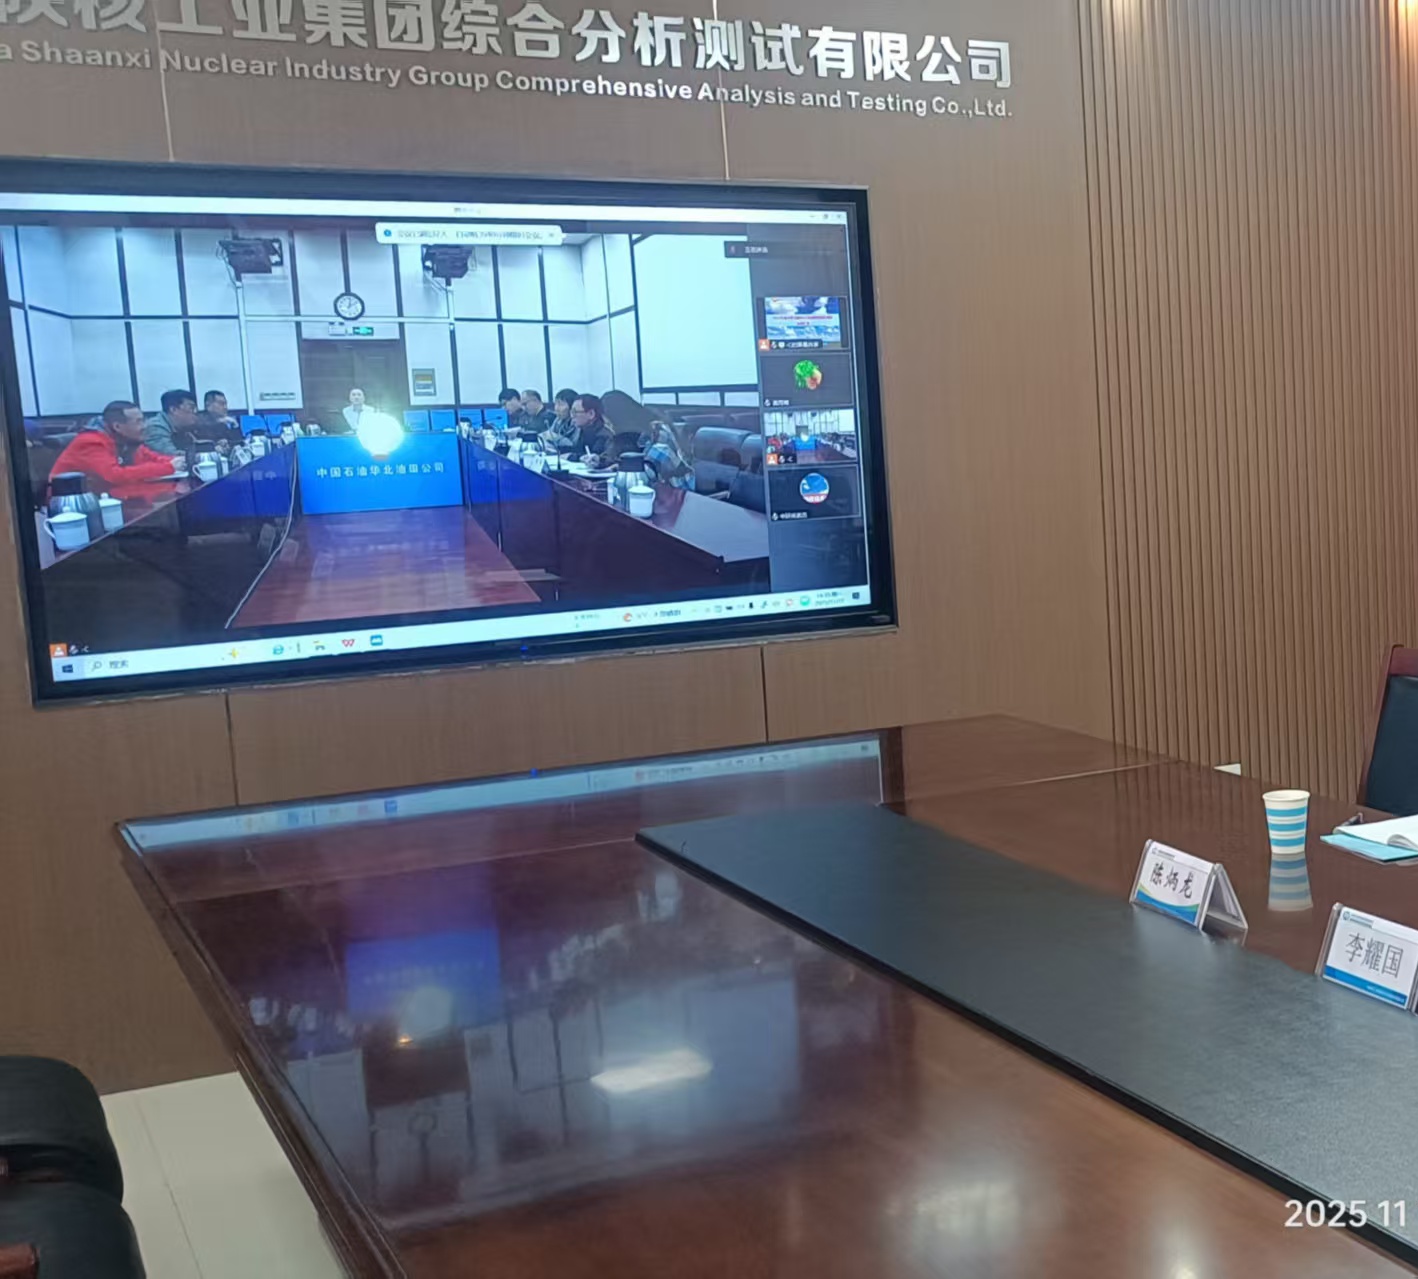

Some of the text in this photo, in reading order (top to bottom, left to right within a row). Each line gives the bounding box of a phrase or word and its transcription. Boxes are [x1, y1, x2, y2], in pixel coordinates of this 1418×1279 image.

[21, 40, 151, 69] Shaanxi
[160, 50, 279, 77] Nuclear
[285, 56, 402, 88] Industry
[408, 65, 490, 92] Group
[495, 70, 693, 99] Comprehensive
[697, 82, 796, 107] Analysis
[800, 90, 842, 108] and
[846, 91, 927, 116] Testing
[931, 97, 1014, 118] Co.,Ltd.
[316, 462, 445, 479] 中国石油华北油田公司
[1345, 933, 1404, 979] 李耀国
